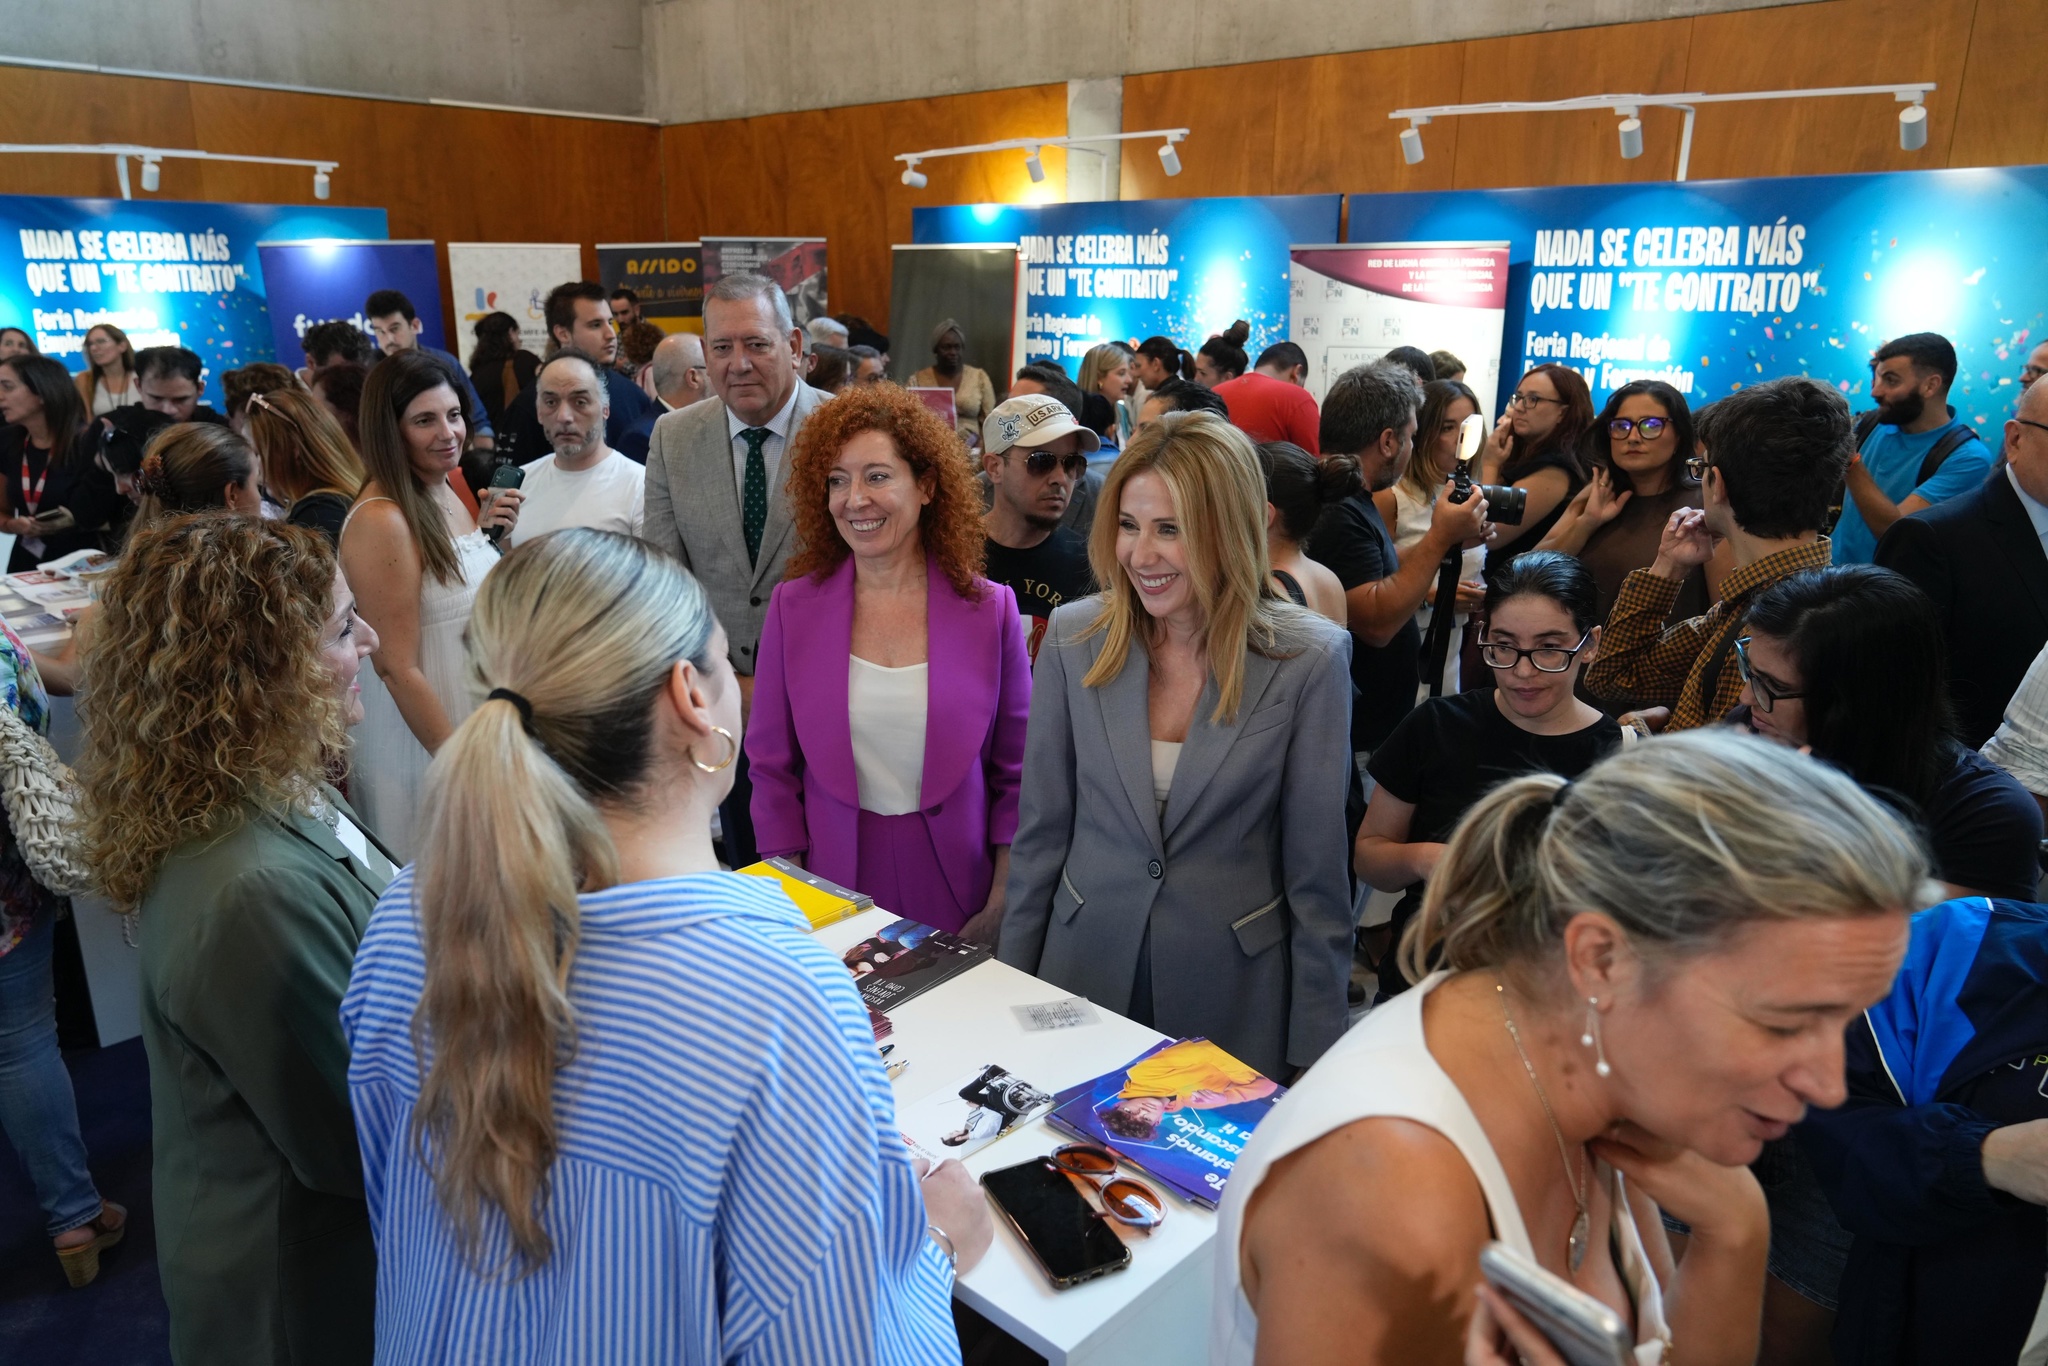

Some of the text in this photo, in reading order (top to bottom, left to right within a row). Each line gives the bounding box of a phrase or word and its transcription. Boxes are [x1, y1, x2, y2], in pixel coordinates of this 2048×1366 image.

[19, 227, 231, 262] NADA SE CELEBRA MÁS
[1020, 228, 1169, 265] NADA SE CELEBRA MÁS
[1533, 215, 1806, 267] NADA SE CELEBRA MÁS
[1367, 259, 1383, 268] RED
[1383, 259, 1394, 268] DE
[1394, 258, 1419, 268] LUCHA
[1409, 271, 1414, 280] Y
[1415, 271, 1426, 280] LA
[25, 262, 244, 297] QUE UN "TE CONTRATO"
[1027, 268, 1178, 300] UE UN "TE CONTRATO"
[1402, 283, 1413, 292] DE
[1413, 283, 1424, 292] LA
[1530, 271, 1819, 314] QUE UN "TE CONTRATO"
[32, 308, 75, 331] Feria
[1043, 312, 1087, 338] Regional
[1087, 314, 1102, 336] de
[1052, 339, 1061, 361] y
[1525, 330, 1671, 365] Feria Regional de
[1023, 578, 1064, 607] YOR
[1217, 1122, 1238, 1135] ti
[1165, 1133, 1235, 1172] stamos
[1204, 1172, 1227, 1191] Te
